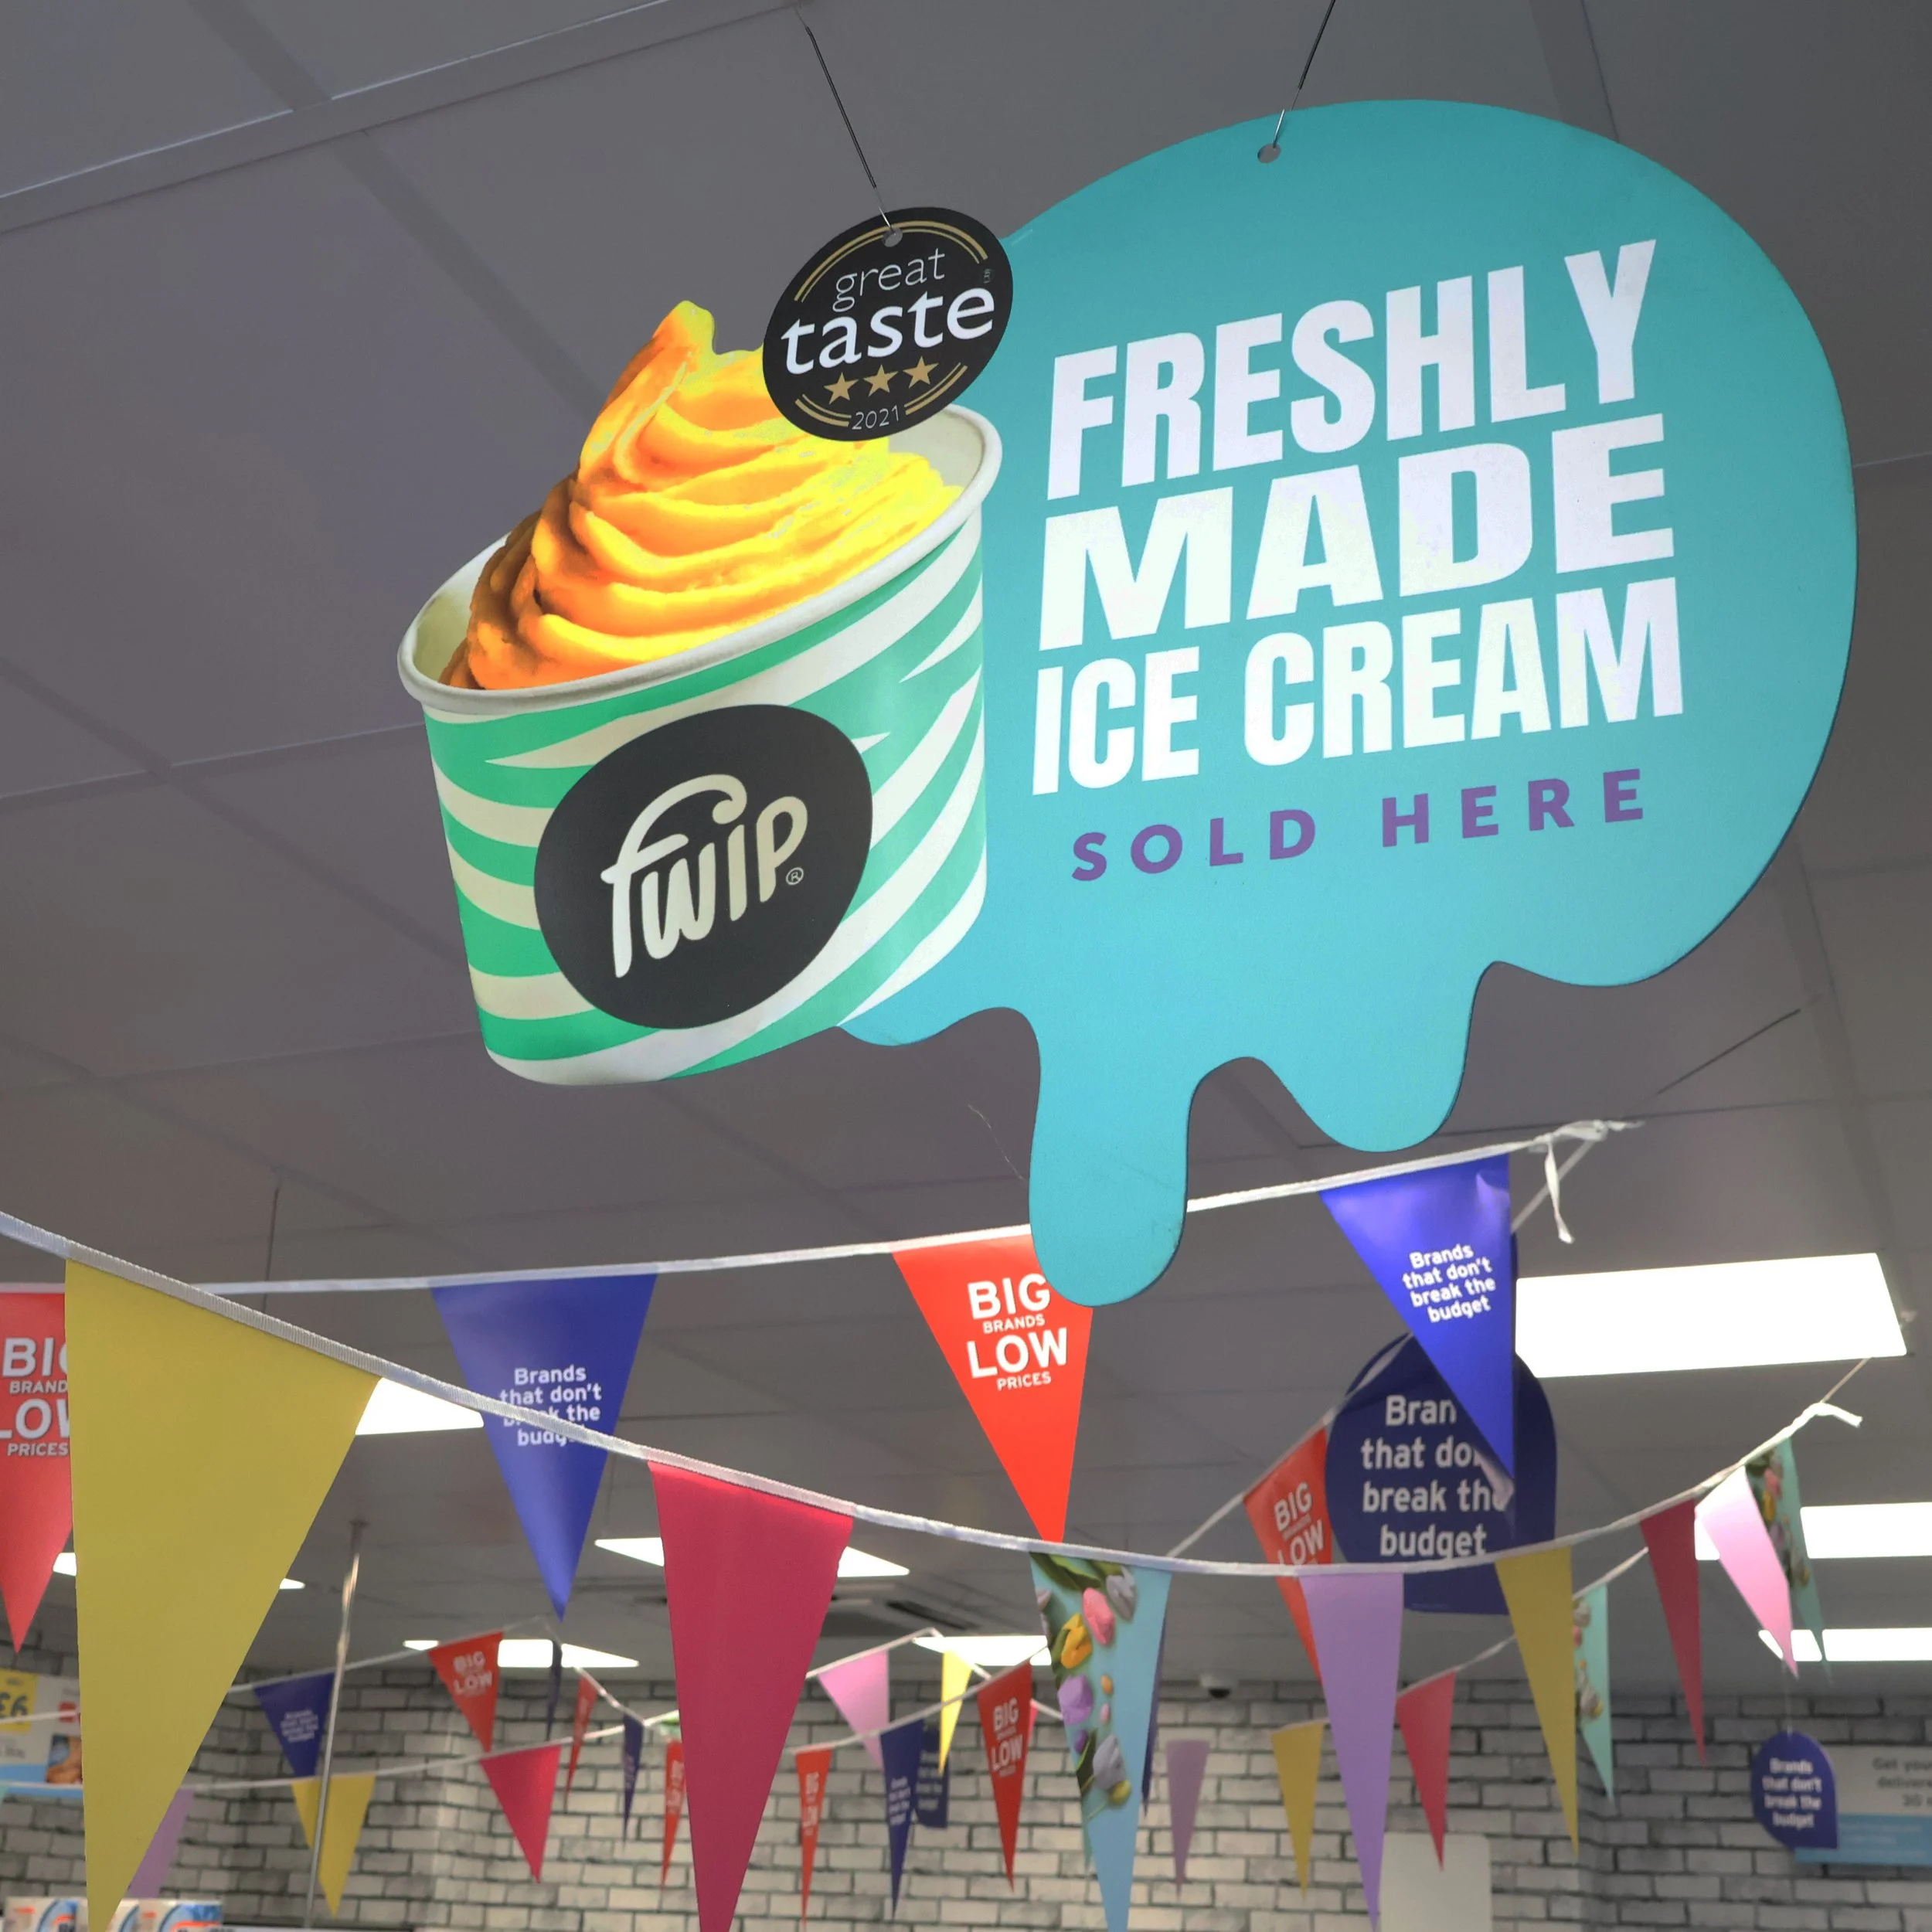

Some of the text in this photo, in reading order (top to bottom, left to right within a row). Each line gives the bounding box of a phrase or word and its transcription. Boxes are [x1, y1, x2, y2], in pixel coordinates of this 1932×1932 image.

[832, 248, 945, 312] great
[781, 287, 995, 375] taste
[1047, 239, 1656, 501] FRESHLY
[852, 405, 900, 430] 2021
[1039, 413, 1674, 651] MADE
[1032, 577, 1683, 796] ICE CREAM
[1071, 769, 1644, 882] SOLD HERE
[1409, 1243, 1475, 1269] Brands
[1402, 1257, 1492, 1289] that don't
[968, 1273, 1051, 1320] BIG
[1410, 1277, 1496, 1308] break the
[1427, 1294, 1492, 1323] budget
[982, 1314, 1046, 1334] BRANDS
[2, 1337, 67, 1377] BI
[967, 1327, 1067, 1379] LOW
[9, 1380, 68, 1394] BRAND
[514, 1365, 587, 1386] Brands
[997, 1371, 1052, 1391] PRICES
[549, 1383, 602, 1403] don't
[566, 1404, 600, 1422] the
[1385, 1394, 1458, 1427] Bran
[7, 1442, 69, 1457] PRICES
[1361, 1435, 1426, 1470] that
[1274, 1481, 1312, 1532] BIG
[1362, 1479, 1447, 1512] break
[1379, 1523, 1488, 1558] budget
[993, 1697, 1019, 1731] BIG
[992, 1733, 1023, 1772] LOW
